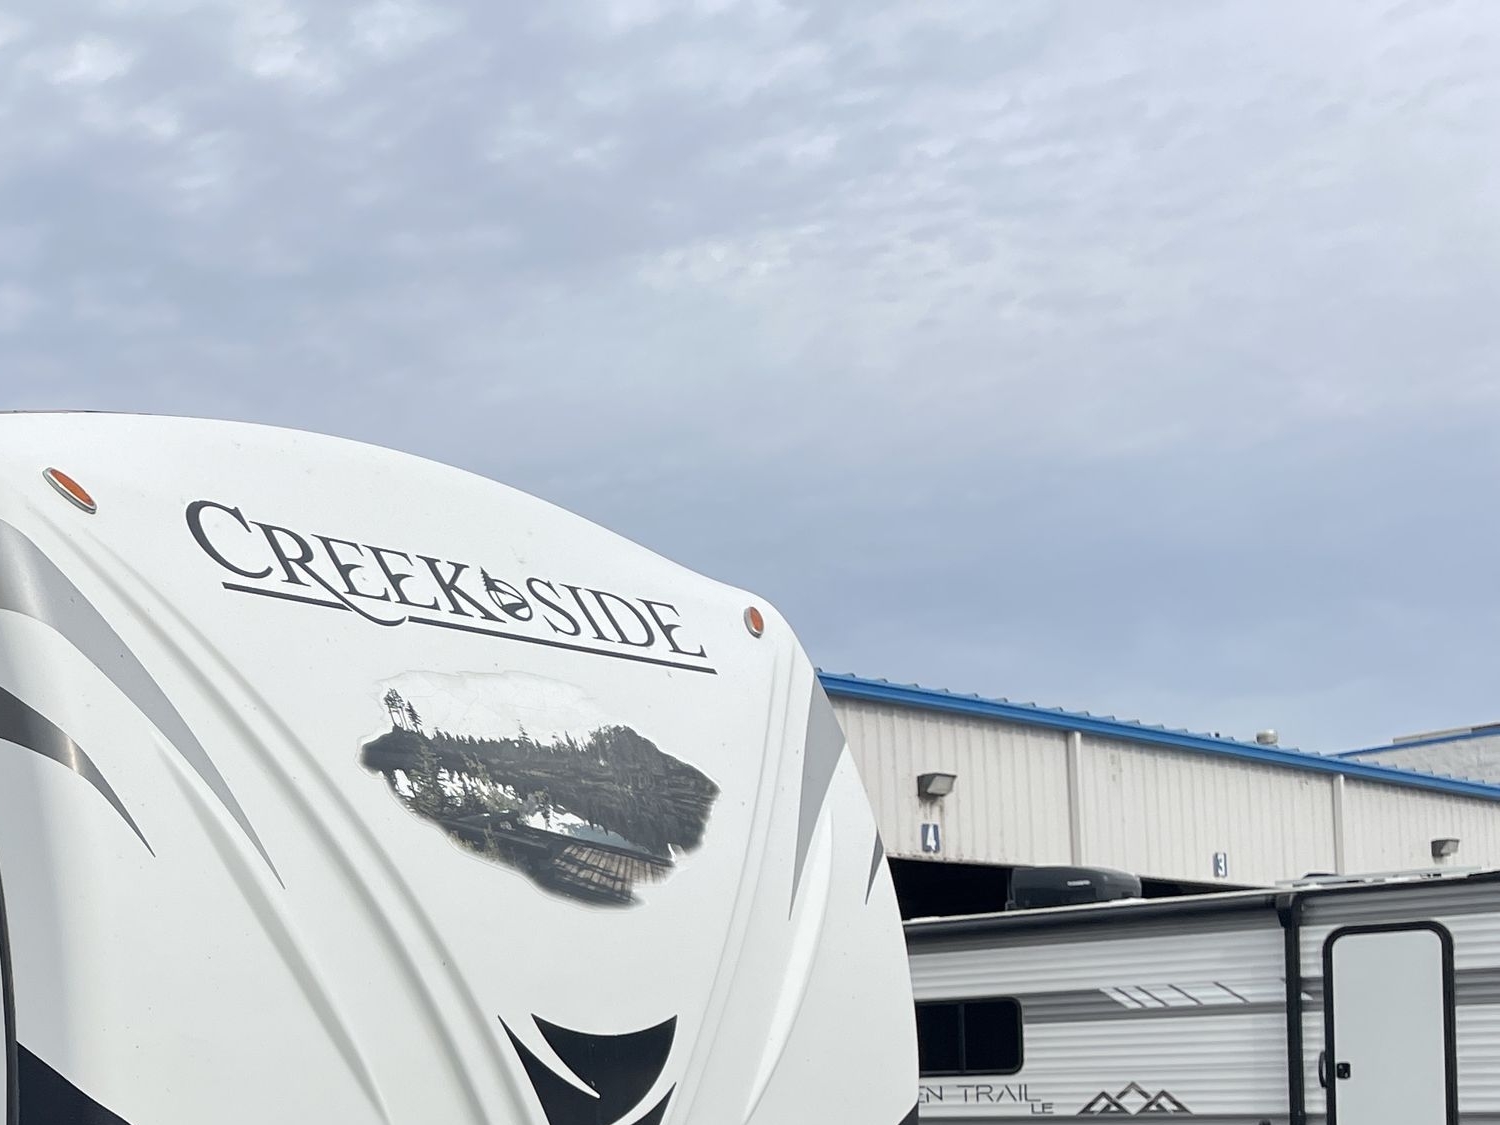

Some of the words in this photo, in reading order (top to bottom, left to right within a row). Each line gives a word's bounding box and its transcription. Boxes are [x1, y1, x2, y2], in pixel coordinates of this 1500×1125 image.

[926, 825, 937, 851] 4
[956, 1084, 1041, 1103] TRAIL
[1031, 1103, 1054, 1115] LE
